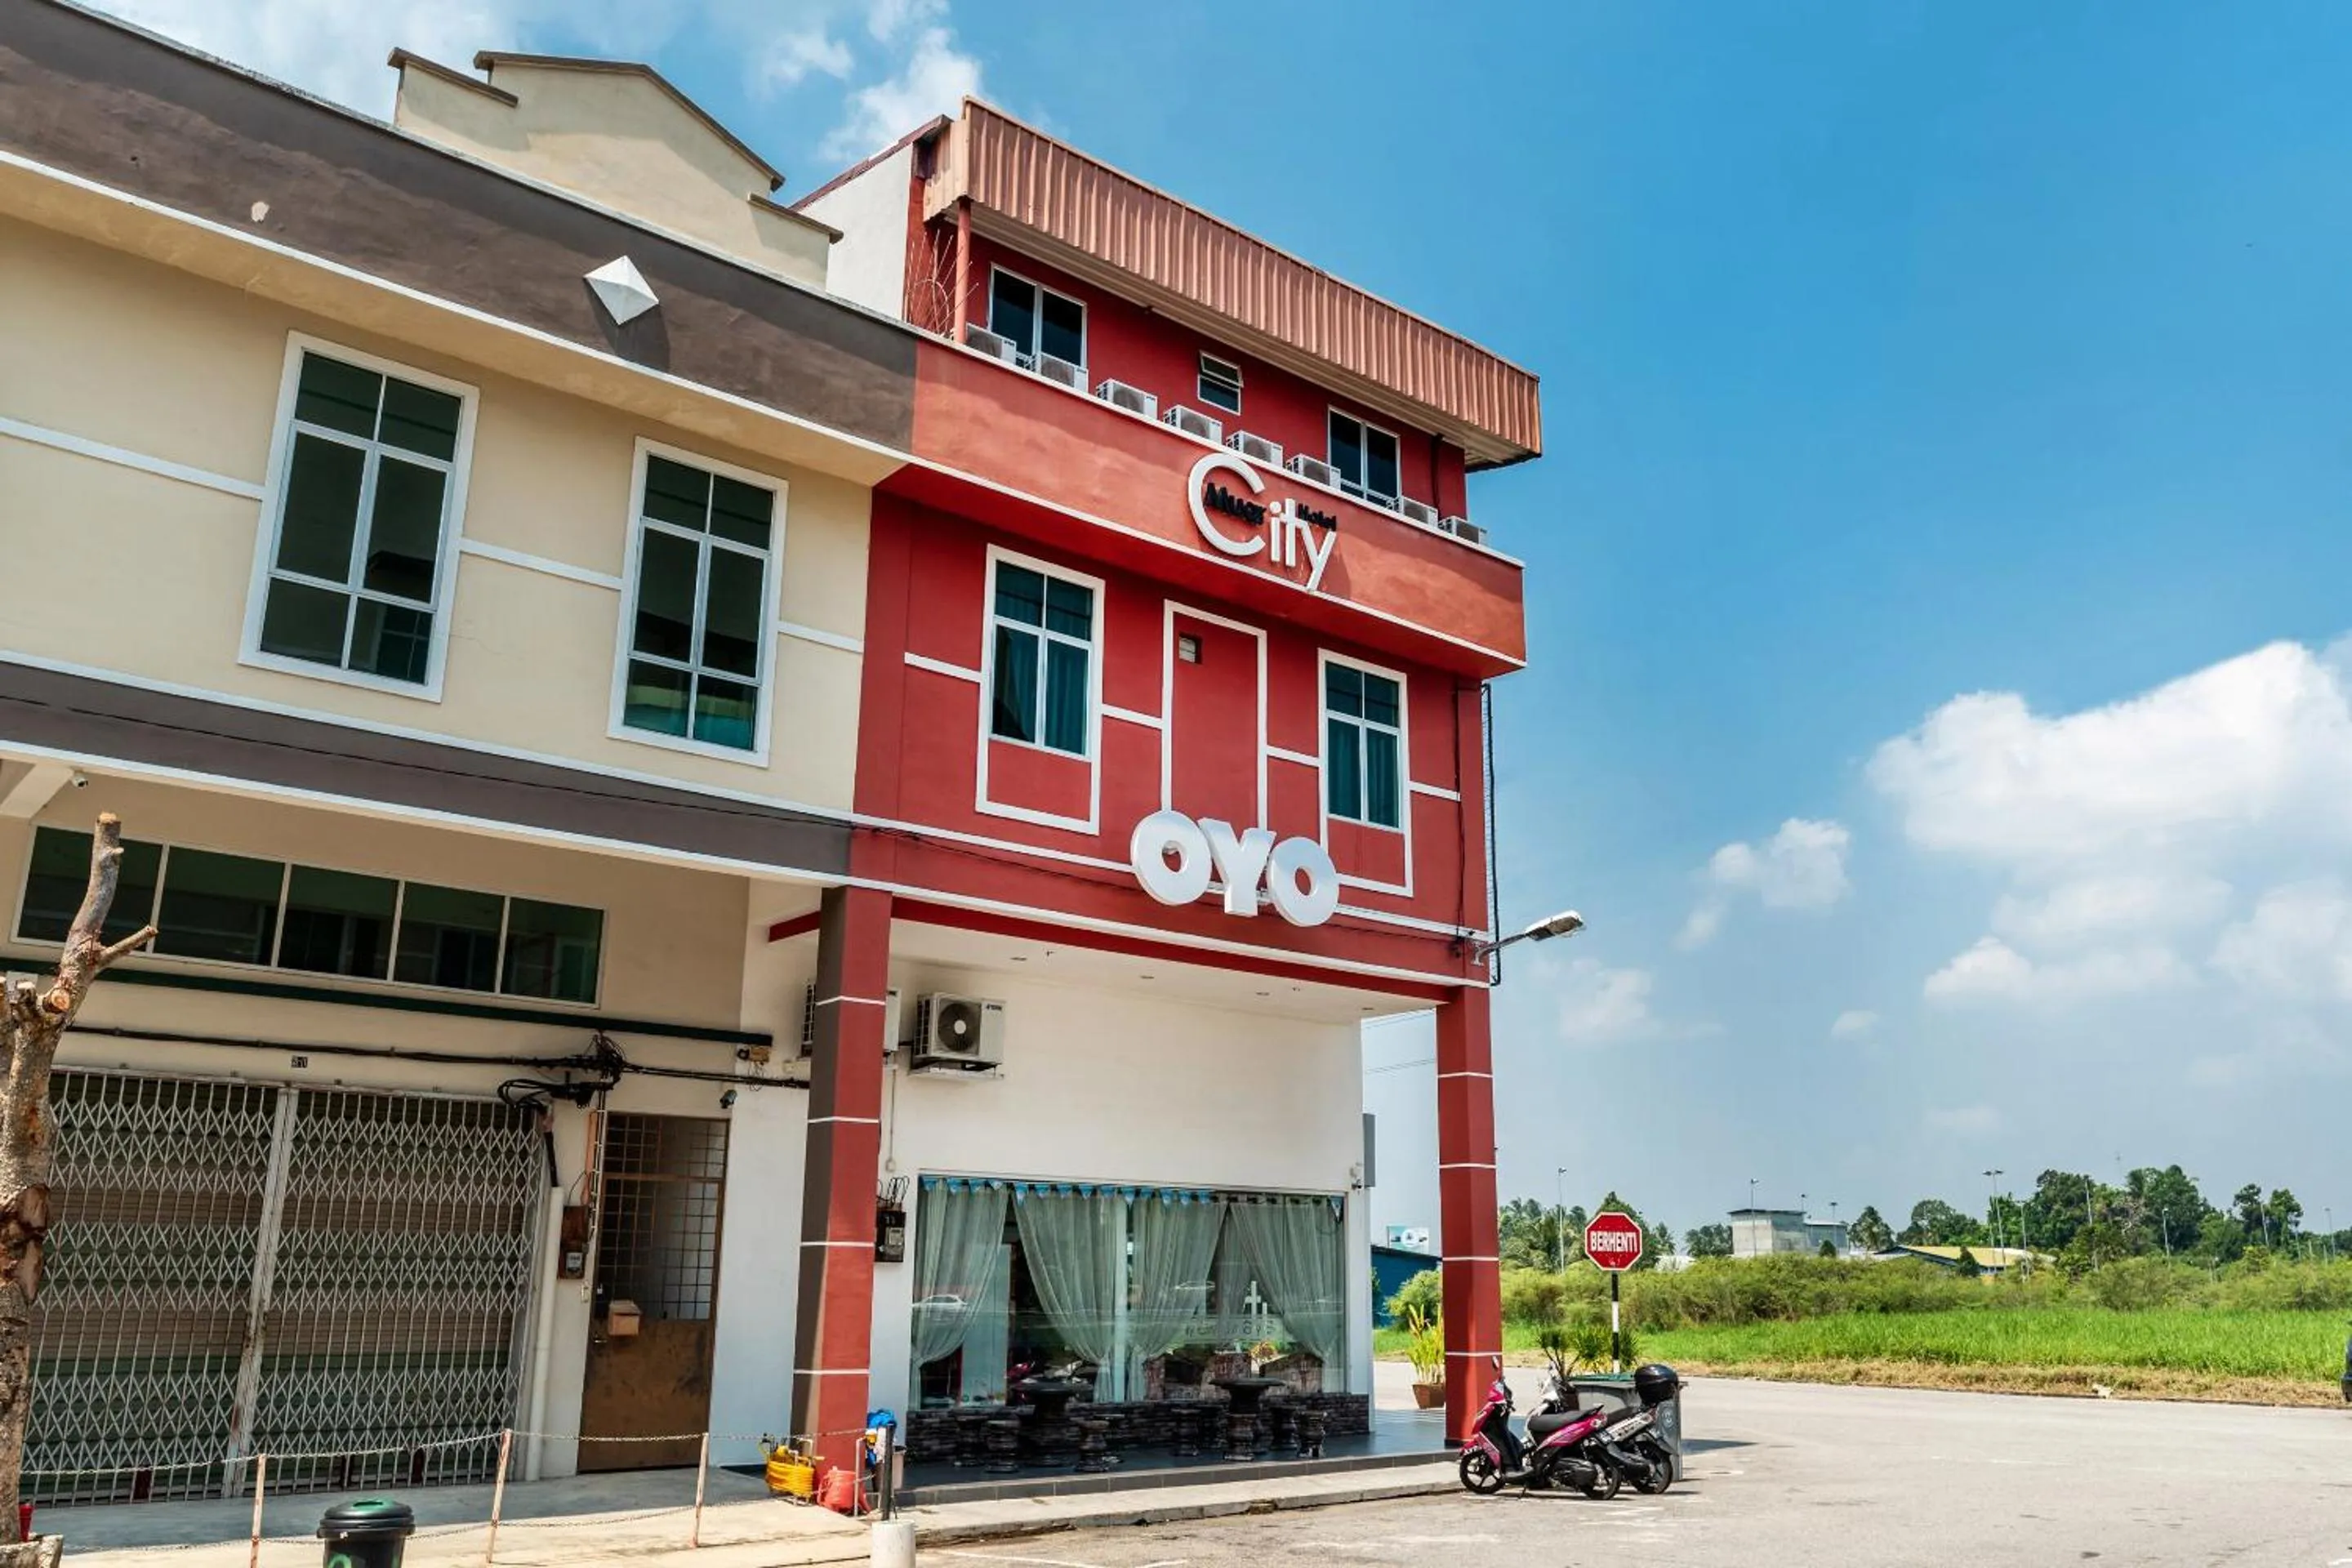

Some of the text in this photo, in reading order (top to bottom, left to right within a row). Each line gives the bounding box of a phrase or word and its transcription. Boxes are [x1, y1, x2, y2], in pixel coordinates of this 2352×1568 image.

[1188, 452, 1338, 593] City
[1130, 810, 1339, 927] OYO
[1589, 1230, 1638, 1253] BERHENTI
